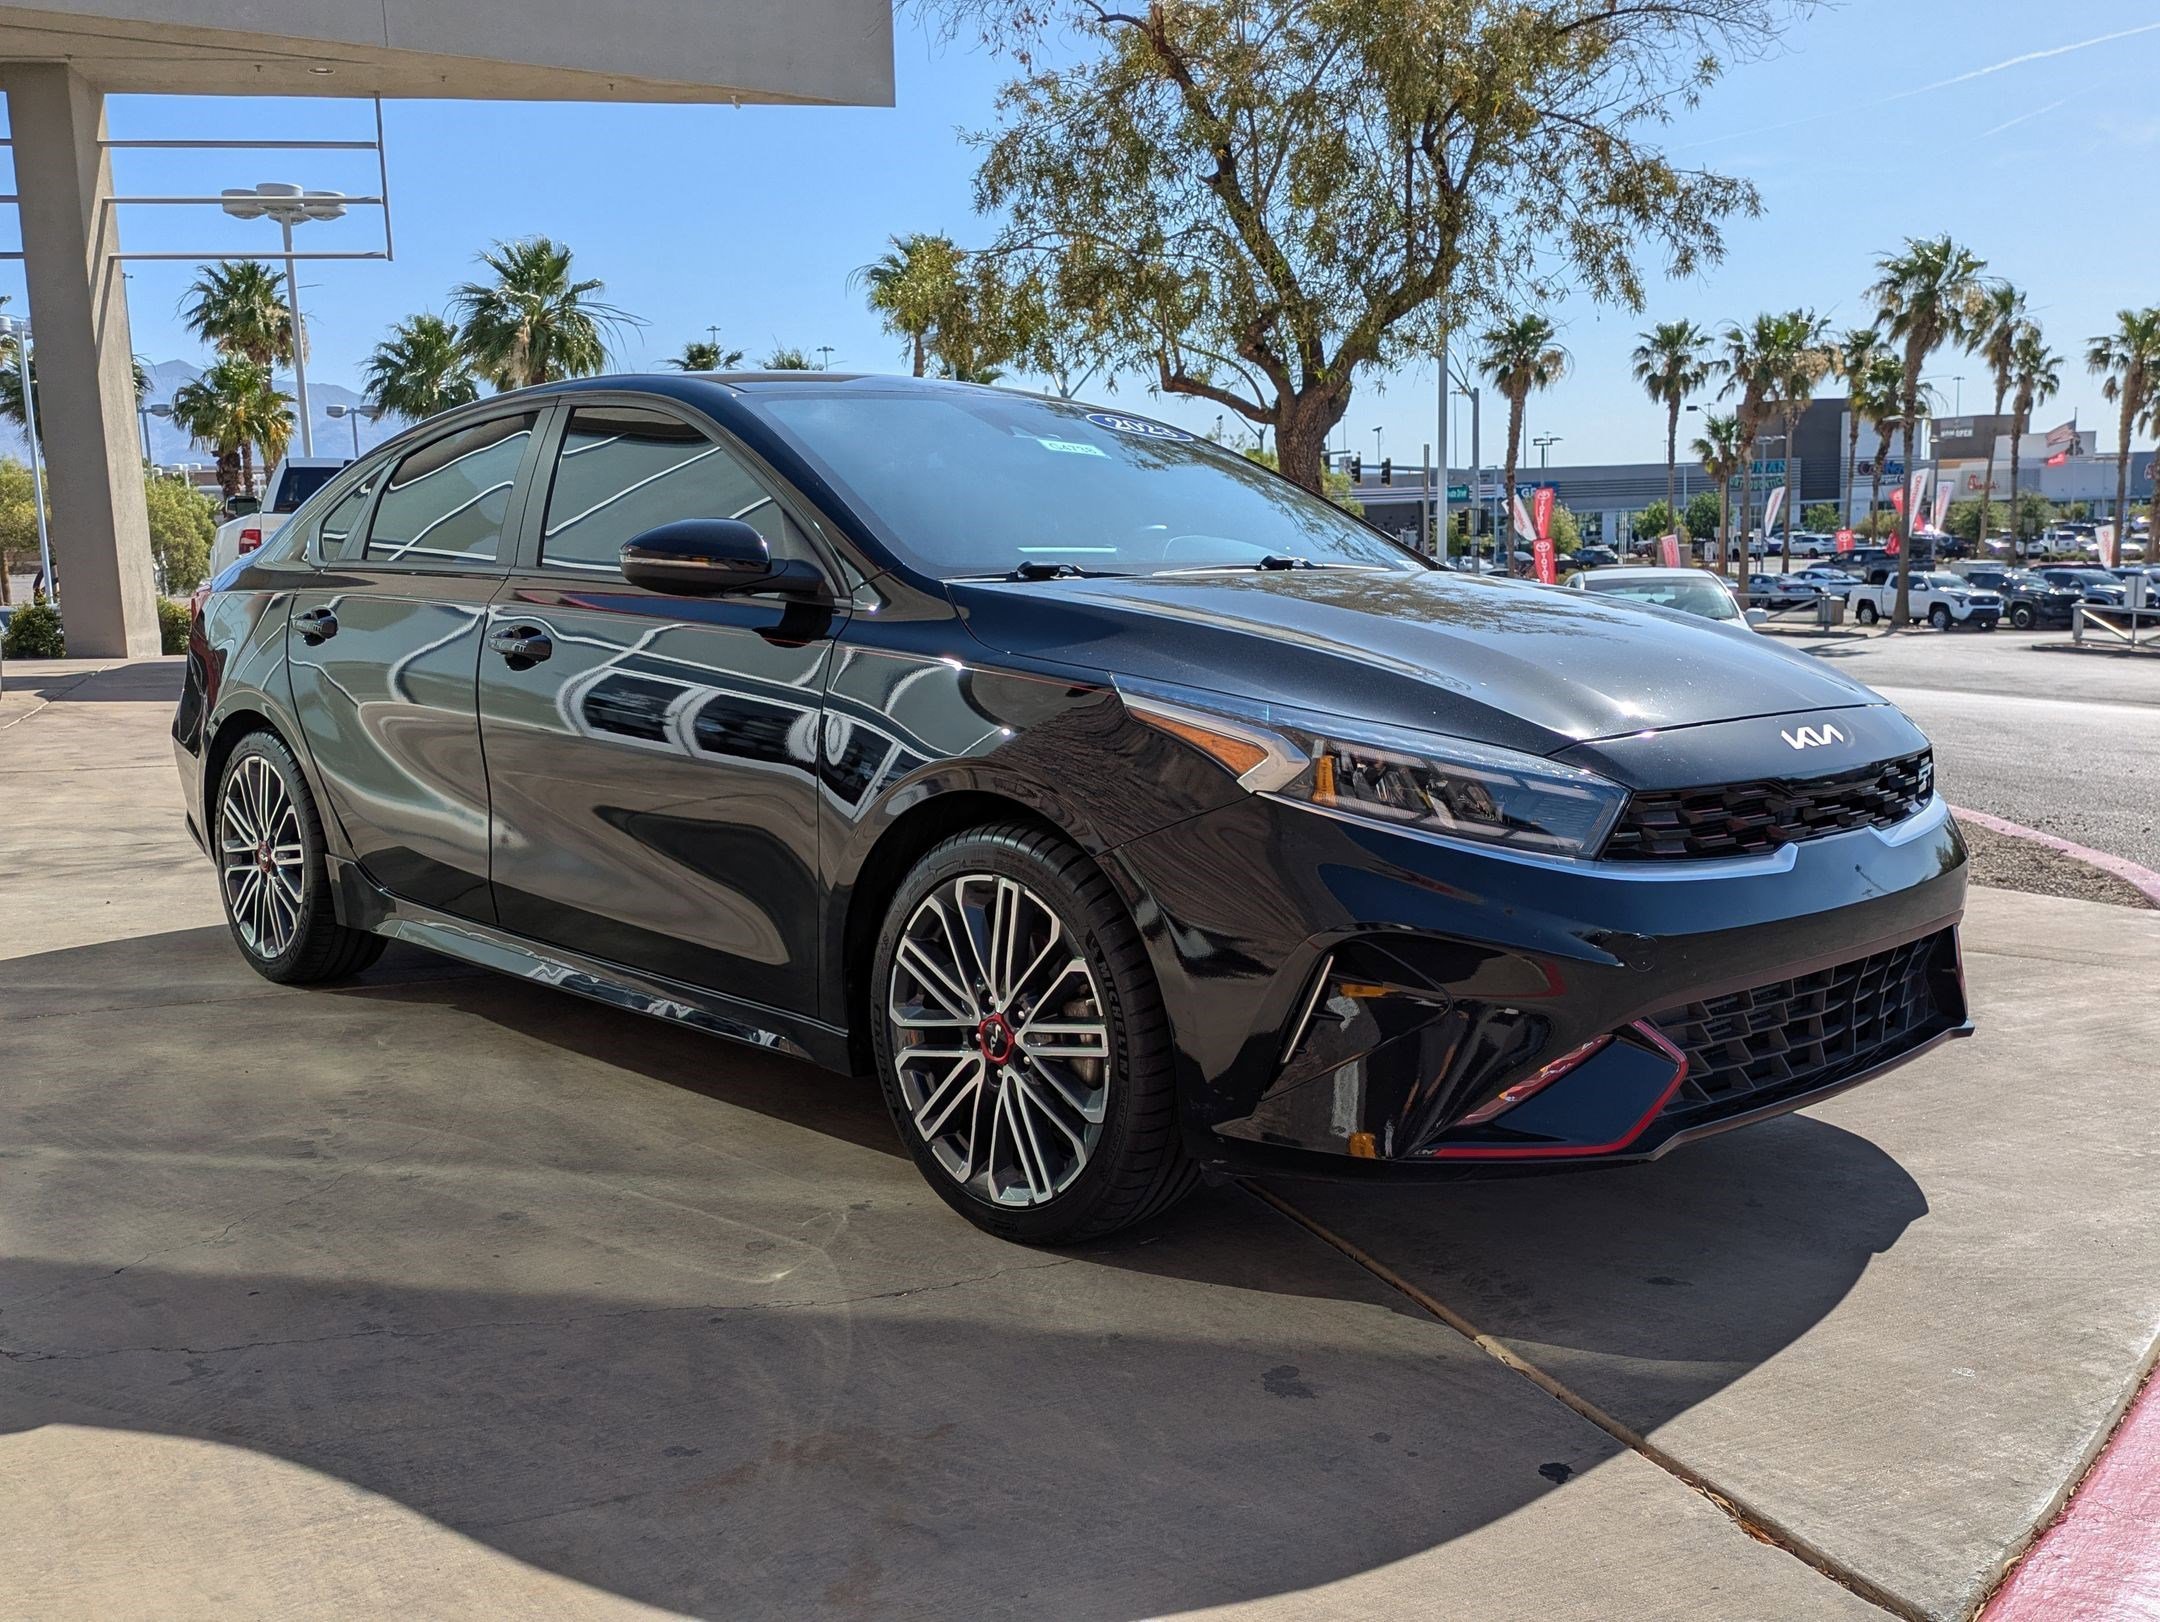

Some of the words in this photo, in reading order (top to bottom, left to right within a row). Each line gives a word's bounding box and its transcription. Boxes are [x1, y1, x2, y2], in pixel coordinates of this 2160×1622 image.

[1104, 417, 1178, 438] 2023
[1781, 723, 1844, 750] KIA
[1098, 960, 1129, 1078] MICHELIN
